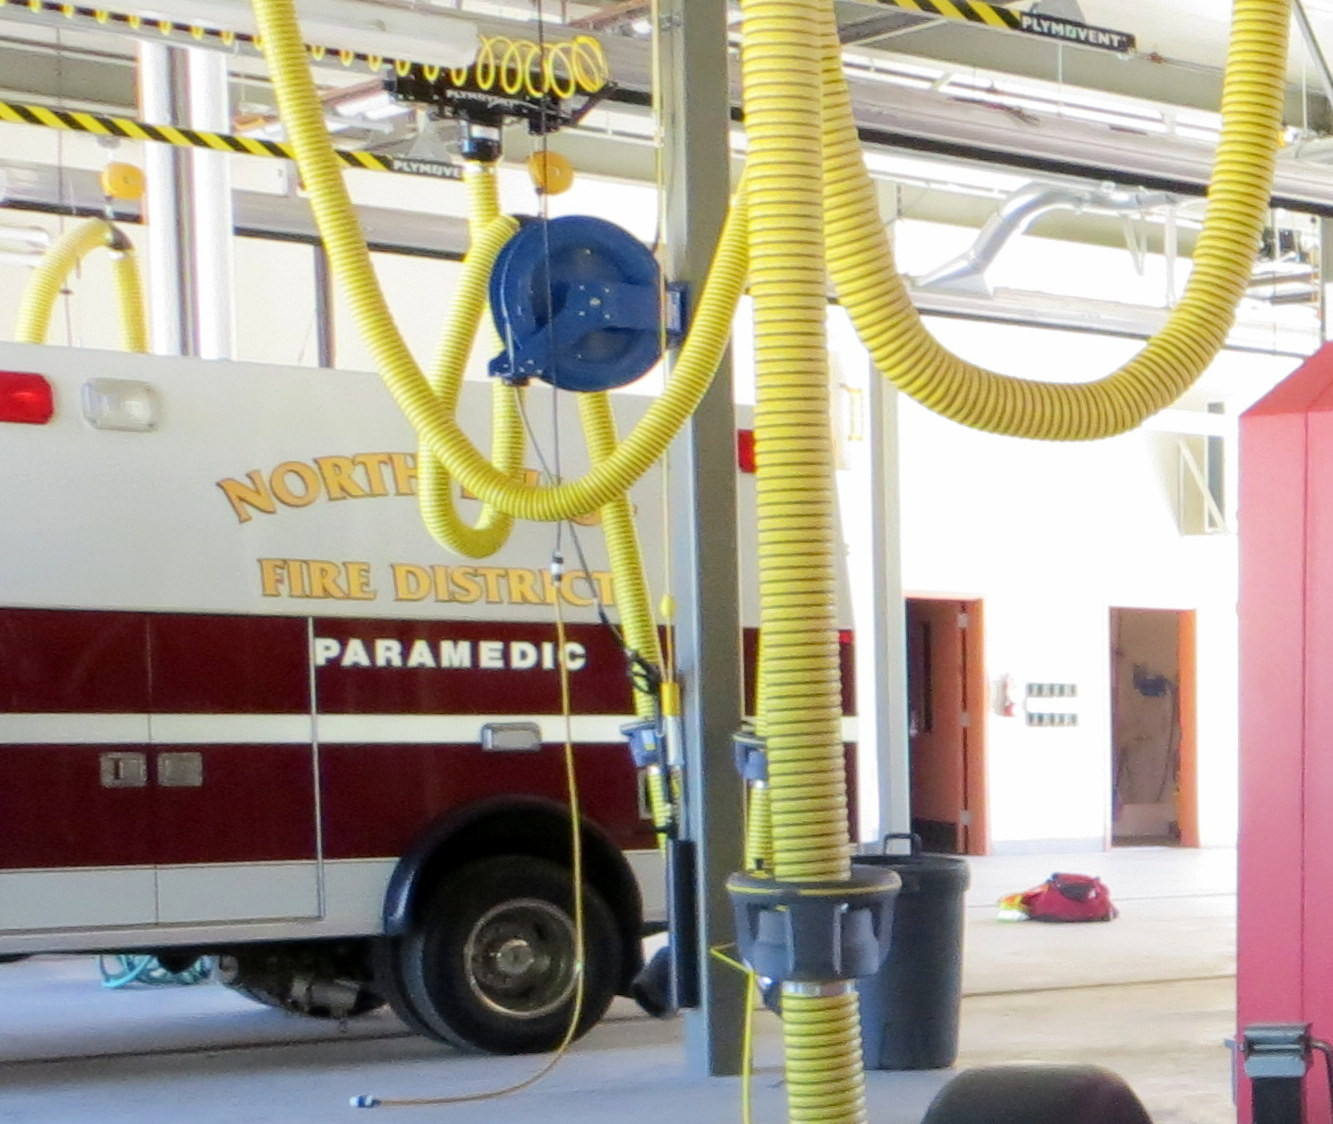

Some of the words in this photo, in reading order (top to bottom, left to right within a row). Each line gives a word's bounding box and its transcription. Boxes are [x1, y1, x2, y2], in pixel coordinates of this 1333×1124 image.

[1021, 15, 1119, 47] PLYMOVENT
[393, 160, 461, 178] PLYMOVE
[258, 557, 377, 601] FIRE
[389, 563, 617, 607] DISTRICT
[314, 636, 587, 671] PARAMEDIC
